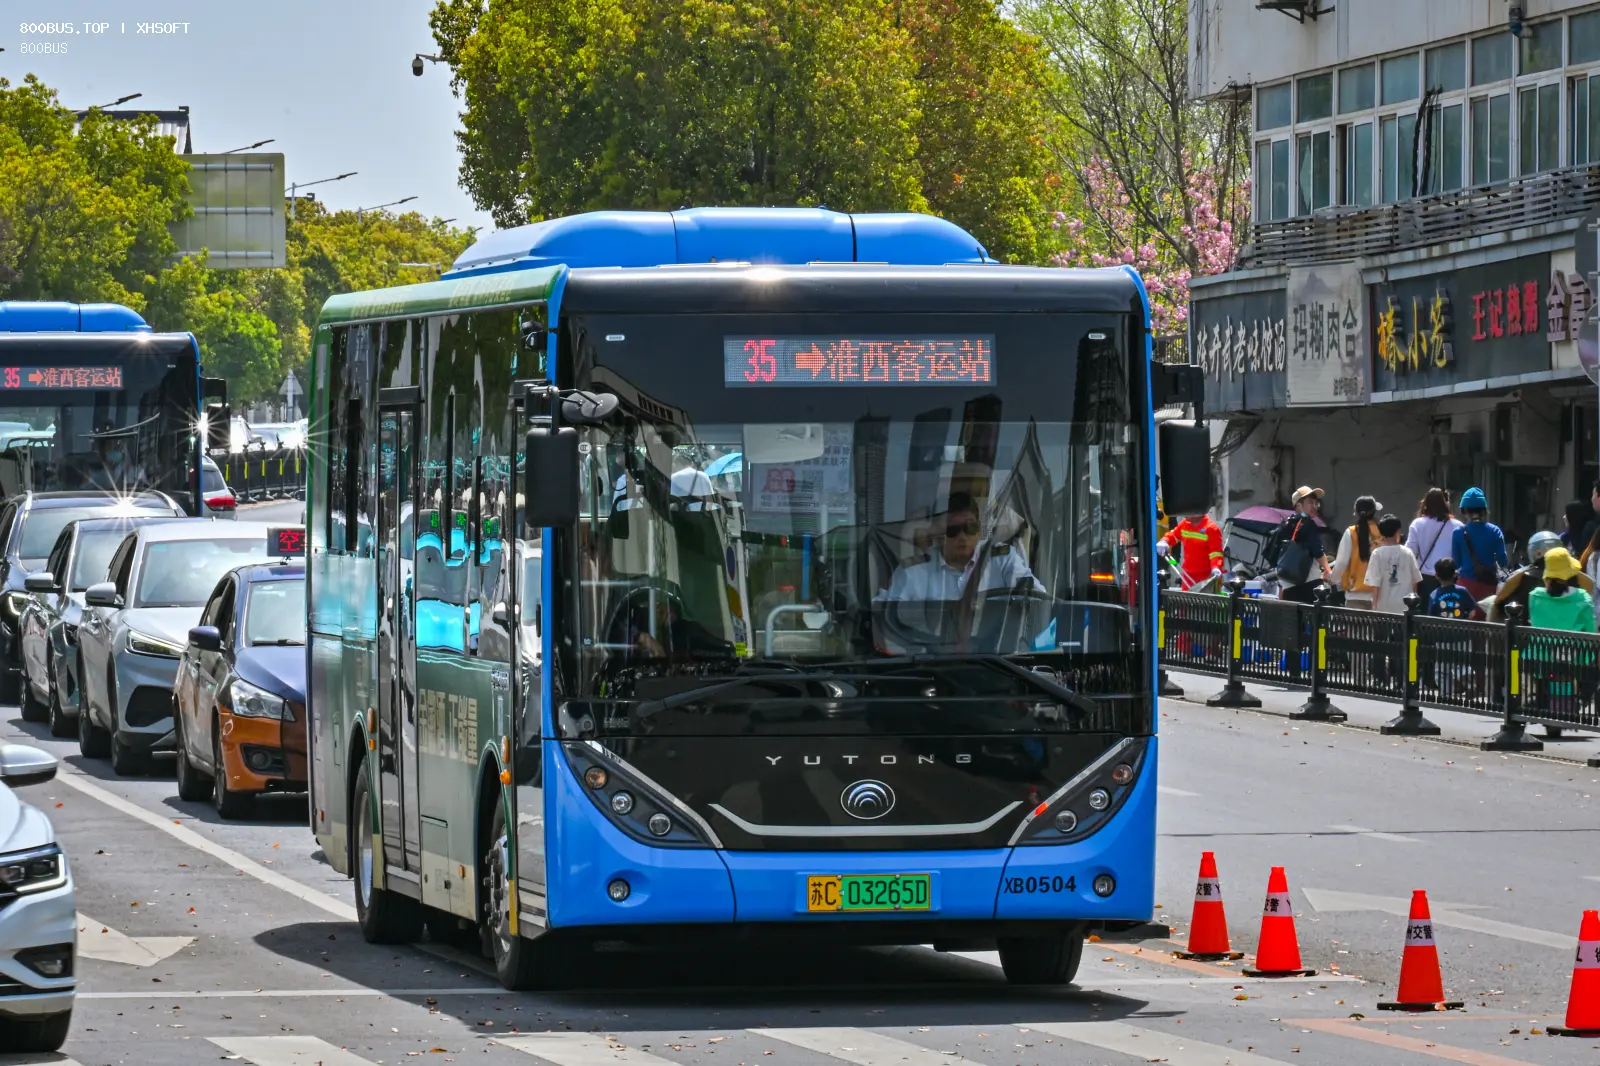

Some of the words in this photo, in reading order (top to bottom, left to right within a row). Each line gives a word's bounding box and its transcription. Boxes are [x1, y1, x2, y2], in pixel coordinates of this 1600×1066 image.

[743, 339, 776, 382] 35
[826, 339, 991, 382] 淮西客运站
[4, 367, 21, 389] 35
[43, 367, 122, 388] 淮西客运站
[765, 753, 973, 766] YUTONG
[810, 880, 838, 906] 苏C
[847, 879, 927, 906] 03265D
[1004, 875, 1077, 894] XB0504
